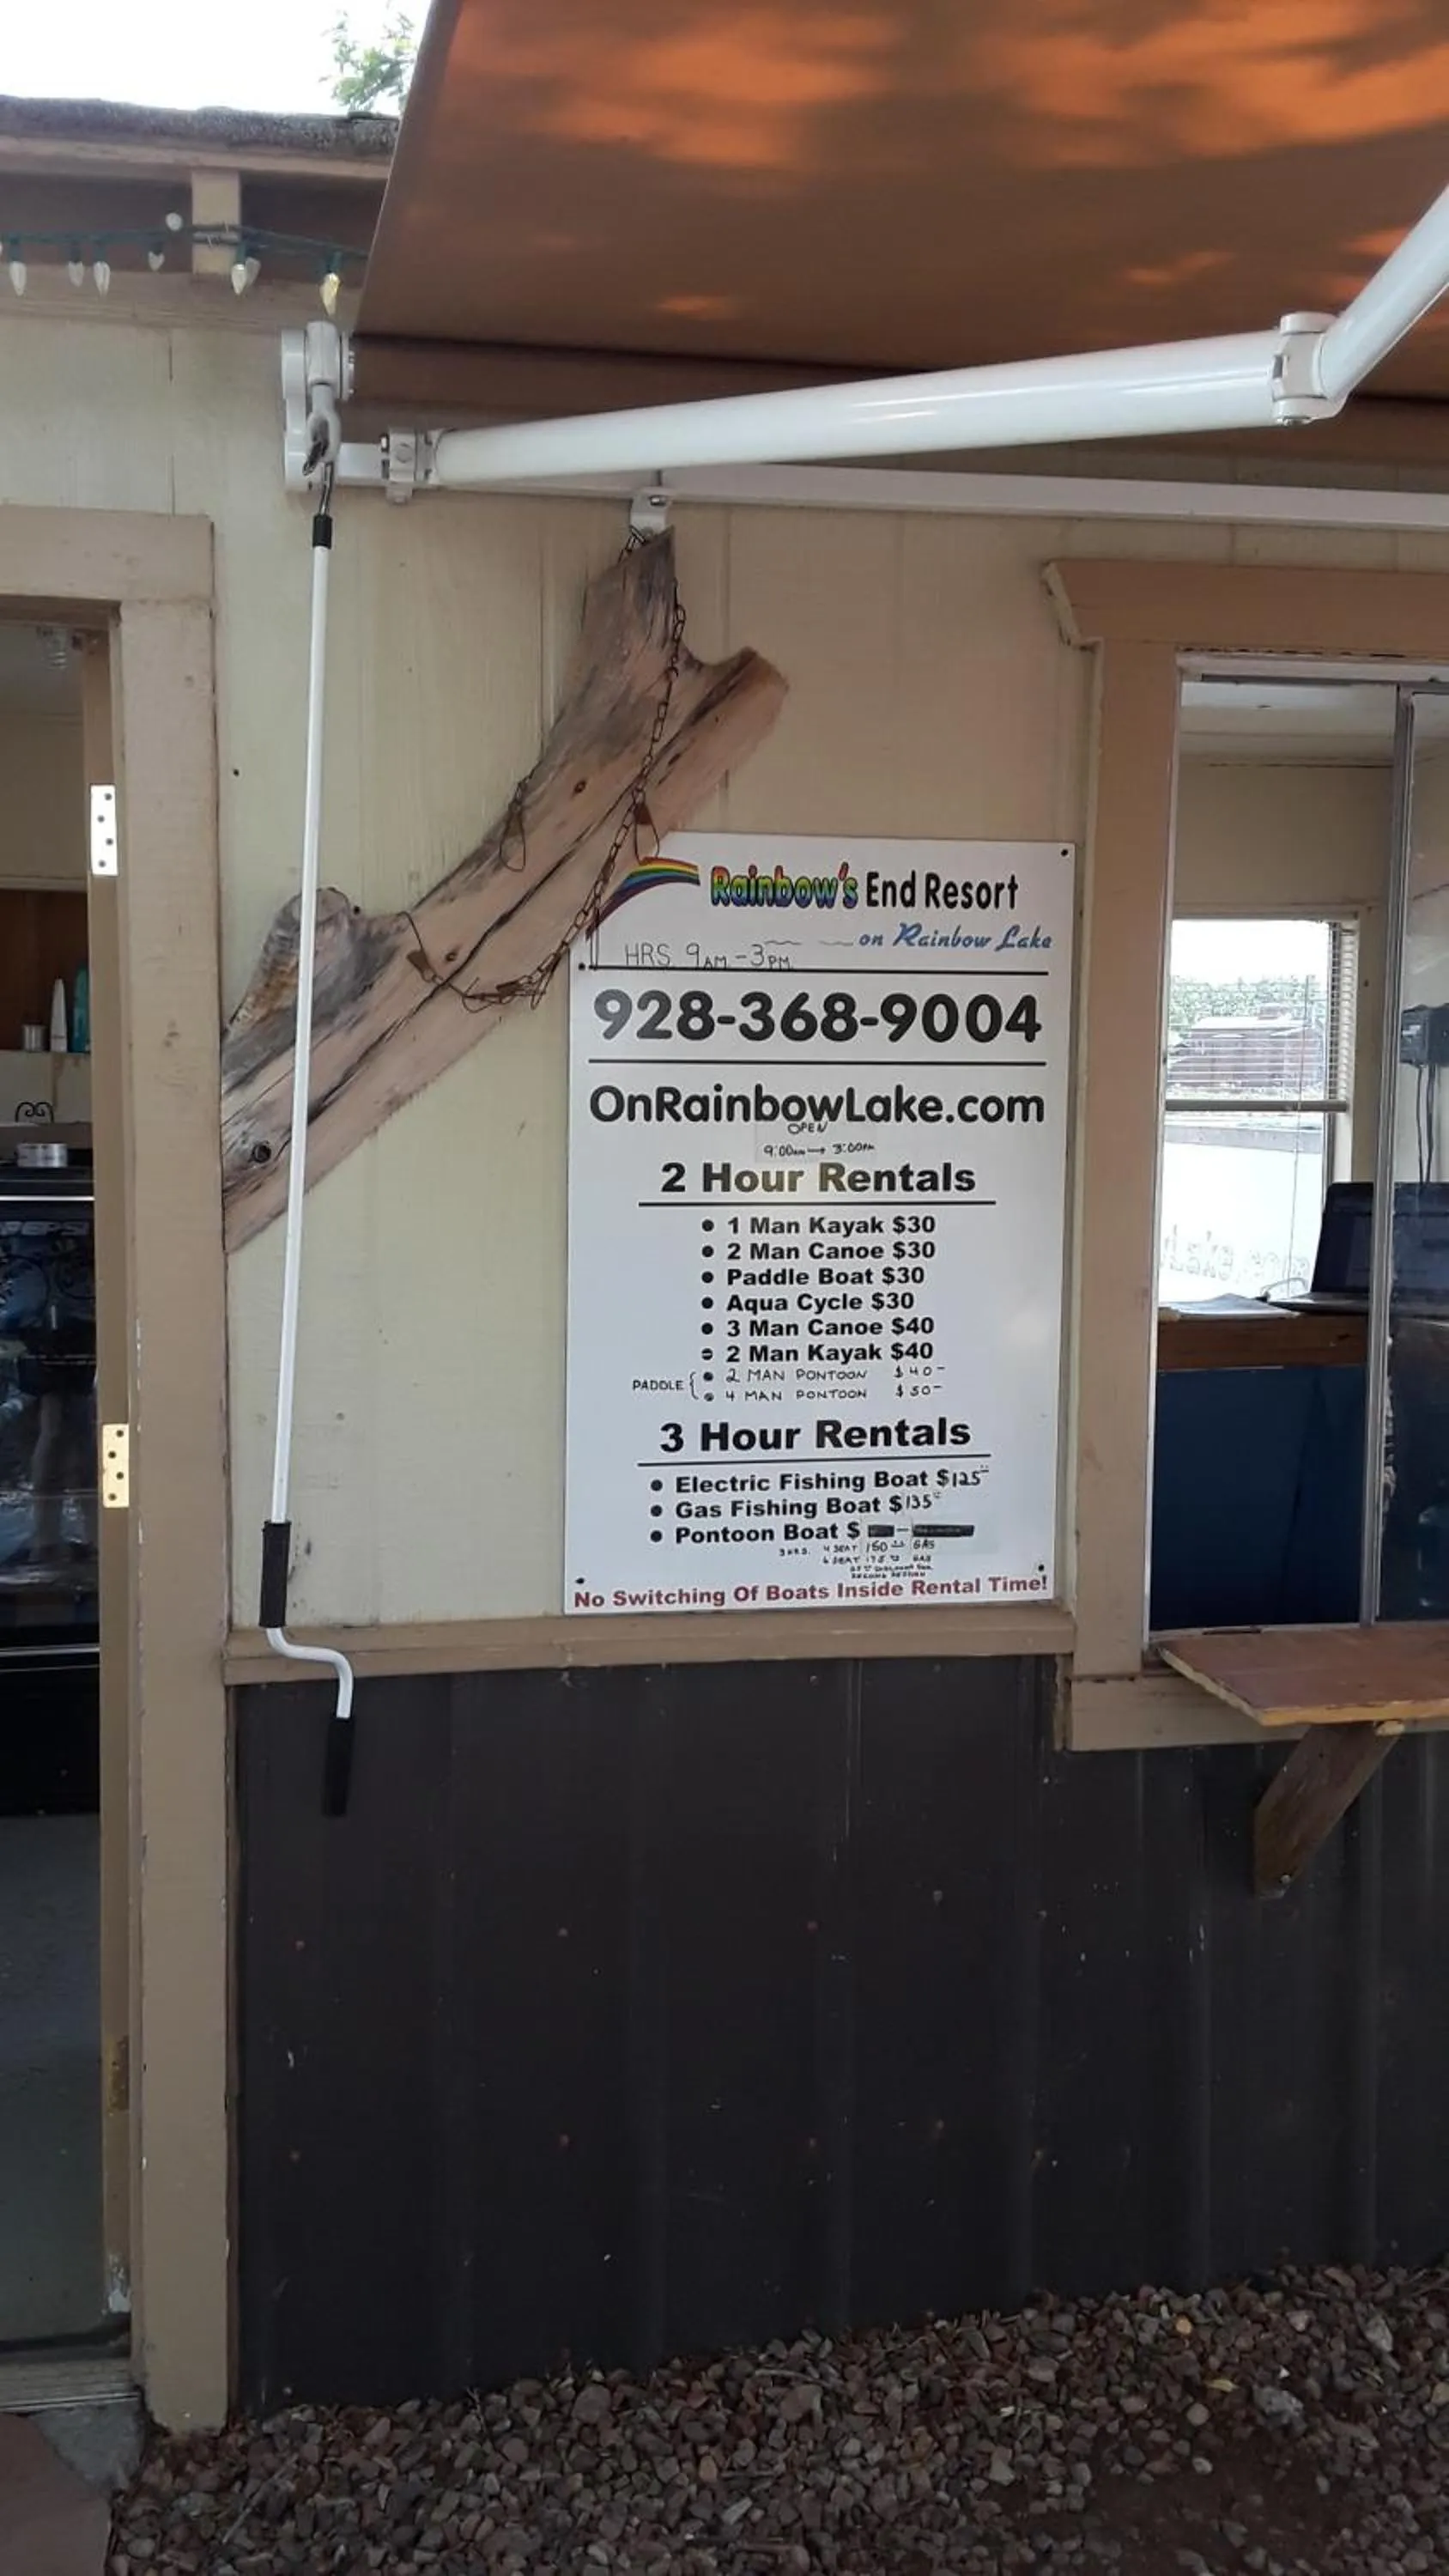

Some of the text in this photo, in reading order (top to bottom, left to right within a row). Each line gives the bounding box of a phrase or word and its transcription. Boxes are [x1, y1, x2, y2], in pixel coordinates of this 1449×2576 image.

[711, 862, 1018, 909] Rainbow's End Resort
[859, 923, 1052, 951] on Rainbow Lake
[594, 988, 1042, 1042] 928-368-9004
[590, 1083, 1045, 1122] OnRainbowLake.com
[787, 1121, 828, 1134] OPEN
[661, 1162, 976, 1192] 2 Hour Rentals
[728, 1216, 936, 1238] 1 Man Kayak $30
[727, 1242, 936, 1261] 2 Man Canoe $30
[727, 1267, 925, 1285] Paddle Boat $30
[727, 1292, 914, 1315] Aqua Cycle $30
[727, 1317, 934, 1336] 3 Man Canoe $40
[726, 1343, 933, 1364] 2 Man Kayak $40
[632, 1379, 683, 1391] PADDLE
[725, 1369, 740, 1382] 2
[747, 1368, 785, 1382] MAN
[796, 1369, 867, 1380] PONTOON
[724, 1391, 735, 1401] 4
[744, 1390, 783, 1401] MAN
[796, 1390, 867, 1400] PONTOON
[659, 1418, 971, 1453] 3 Hour Rentals
[676, 1473, 771, 1493] Electric
[779, 1473, 866, 1494] Fishing
[874, 1471, 928, 1489] Boat
[676, 1502, 723, 1520] Gas
[731, 1498, 817, 1519] Fishing
[826, 1496, 880, 1516] Boat
[676, 1522, 860, 1545] Pontoon Boat $
[574, 1575, 1048, 1608] No Switching Of Boats Inside Rental Time!
